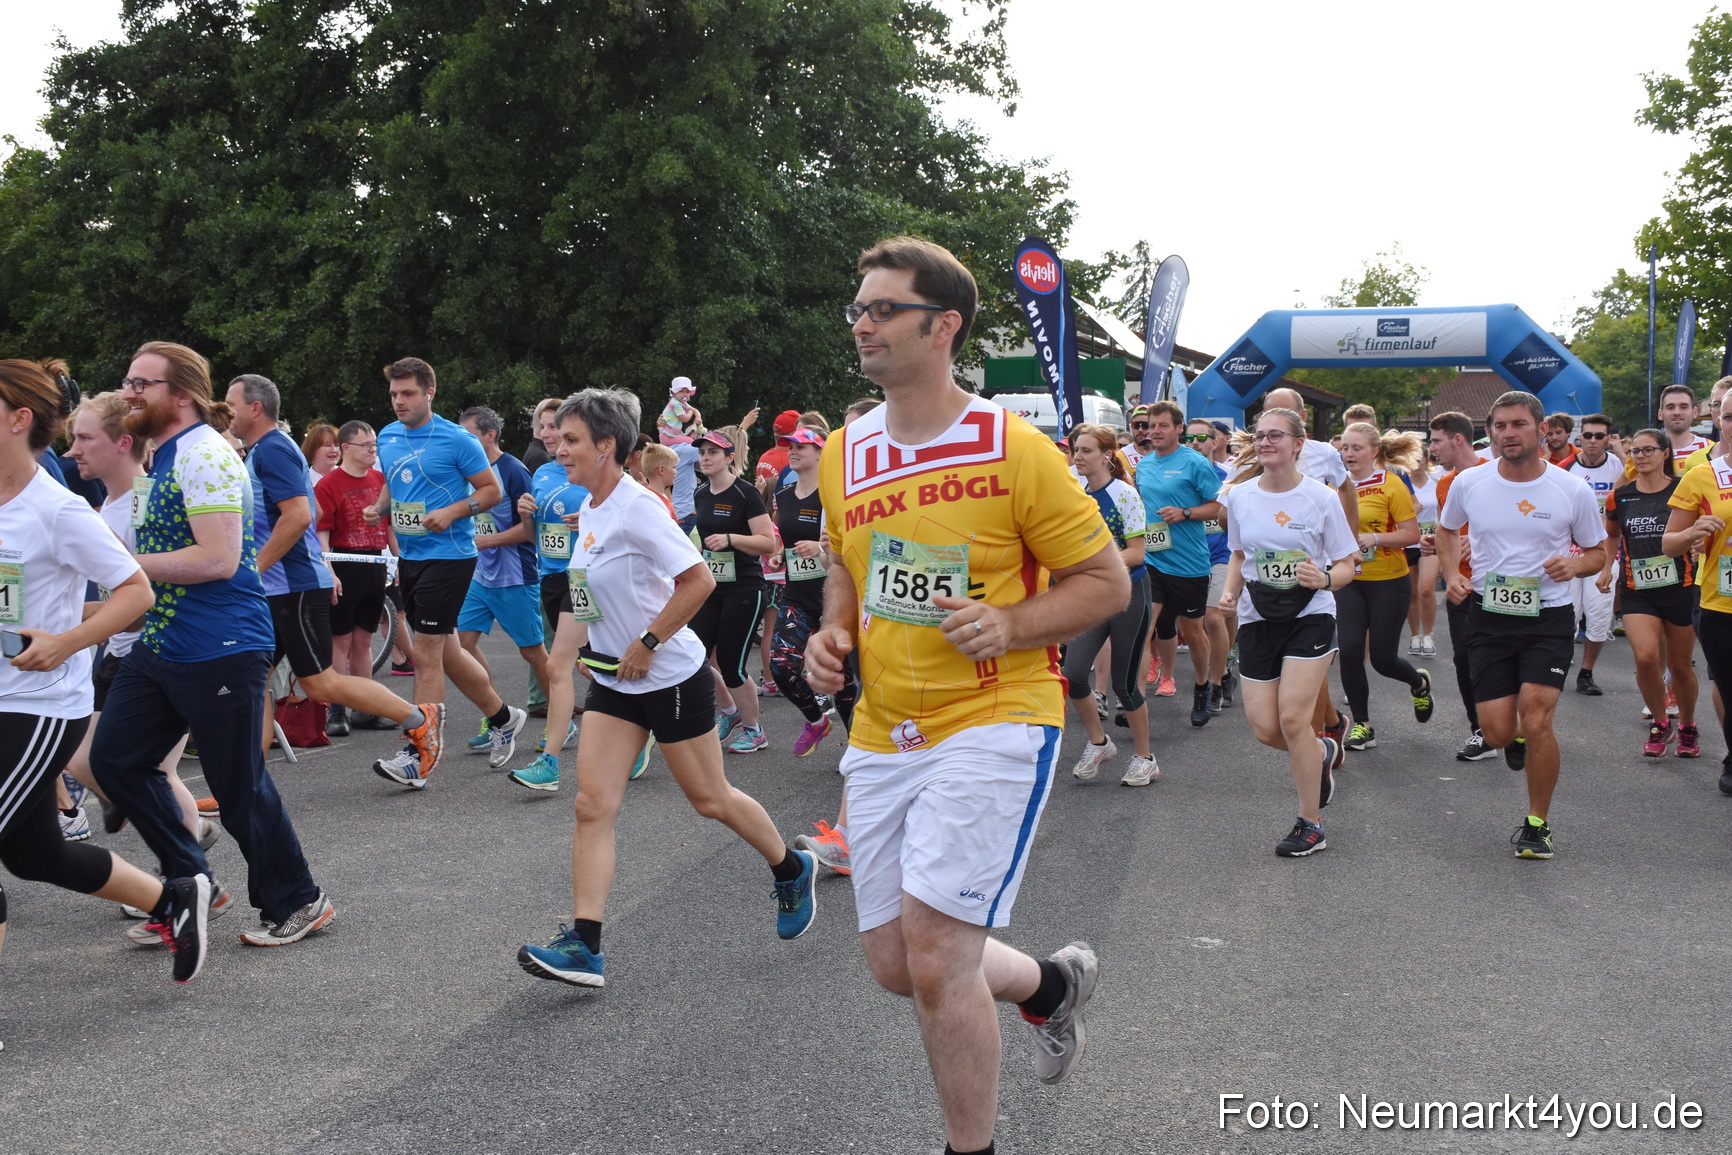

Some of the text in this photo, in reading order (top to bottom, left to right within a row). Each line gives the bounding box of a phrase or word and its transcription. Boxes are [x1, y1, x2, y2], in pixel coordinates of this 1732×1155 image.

[1364, 336, 1438, 351] firmenlauf
[1229, 362, 1268, 372] Fischer
[845, 473, 1010, 534] MAX BÖGL
[393, 512, 420, 526] 1534
[1625, 516, 1658, 527] HECK
[540, 535, 565, 549] 1535
[793, 558, 817, 571] 143
[940, 566, 962, 574] 2019
[1637, 565, 1669, 581] 1017
[878, 564, 953, 603] 1585
[878, 594, 917, 610] Graßmuck
[1490, 587, 1533, 605] 1363
